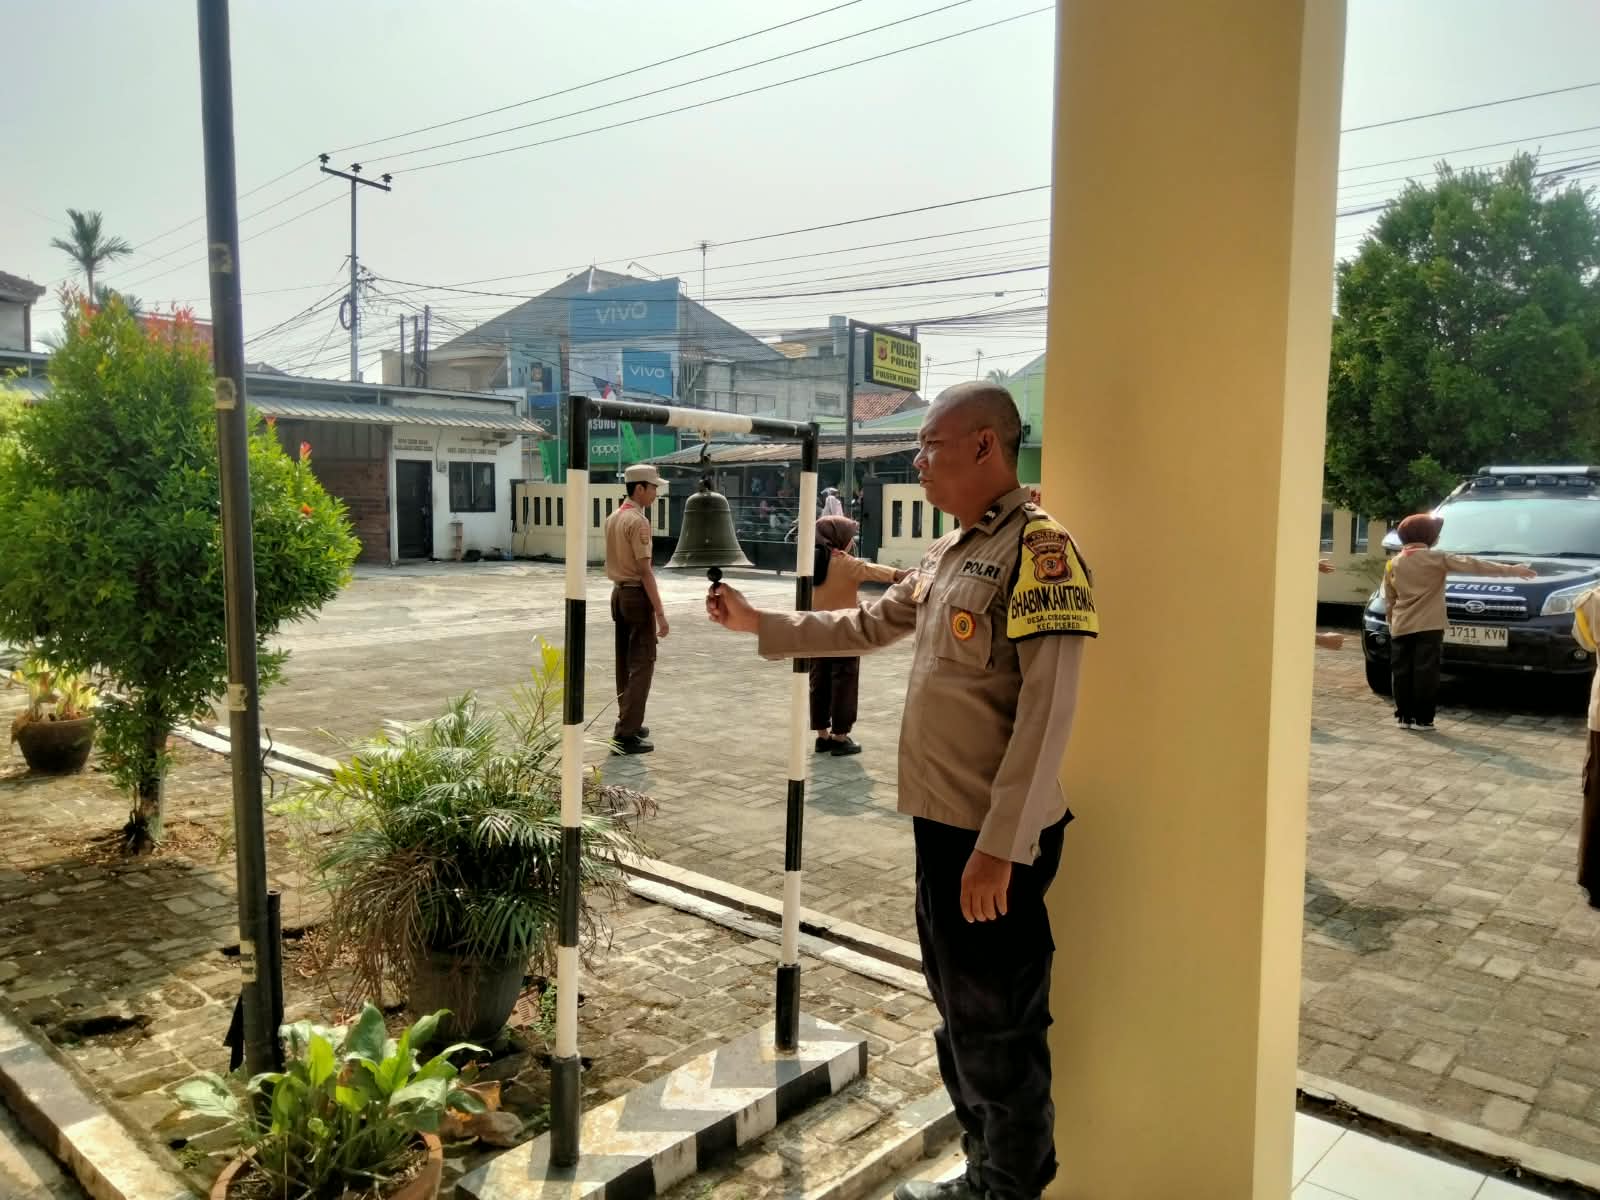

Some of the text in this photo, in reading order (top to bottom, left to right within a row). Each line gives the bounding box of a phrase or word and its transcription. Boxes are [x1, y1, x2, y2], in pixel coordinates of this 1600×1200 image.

[596, 301, 648, 324] vivo
[891, 341, 917, 361] POLISI
[891, 356, 917, 370] POLICE
[630, 366, 665, 378] vivo
[592, 444, 619, 457] oppo
[963, 561, 1000, 579] POLRI
[1449, 627, 1506, 640] 1711 KYN
